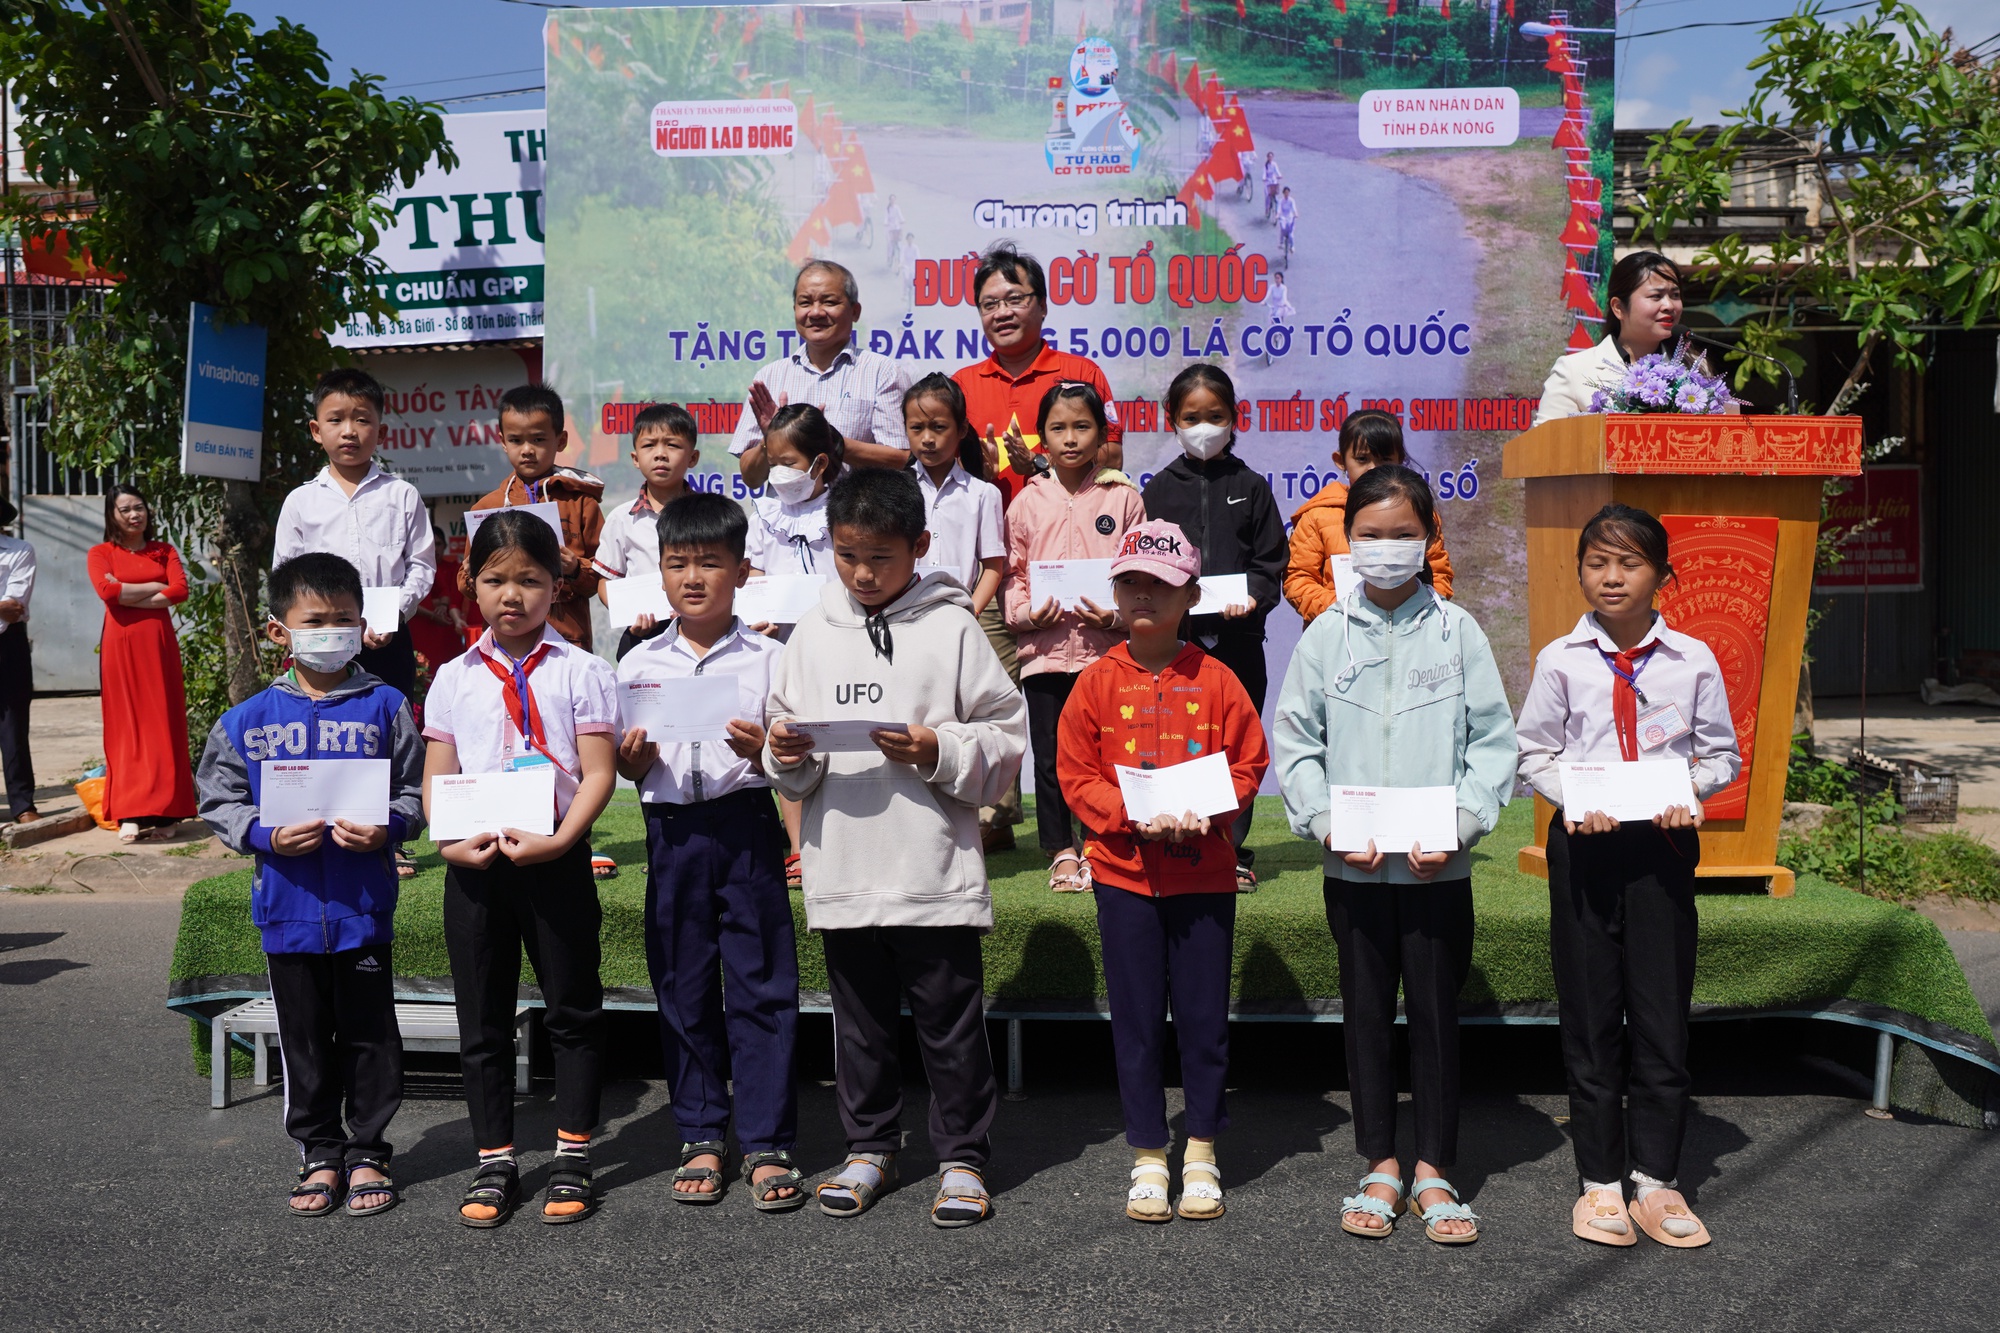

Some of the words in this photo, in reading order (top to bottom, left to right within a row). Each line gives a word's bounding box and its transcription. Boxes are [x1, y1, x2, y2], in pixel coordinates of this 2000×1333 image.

[773, 105, 794, 113] MINH
[1373, 96, 1392, 113] ỦY
[1396, 99, 1425, 112] BAN
[1429, 95, 1470, 111] NHÂN
[1474, 95, 1505, 110] DÂN
[656, 125, 707, 150] NGƯỜI
[711, 126, 743, 149] LAO
[747, 124, 793, 149] ĐỘNG
[1382, 119, 1416, 136] TỈNH
[1453, 119, 1495, 134] NÔNG
[973, 199, 1097, 237] Chương
[1106, 195, 1188, 227] trình
[395, 271, 477, 303] CHUẨN
[483, 275, 529, 297] GPP
[1049, 249, 1100, 306] CỜ
[1108, 240, 1156, 305] TỔ
[1168, 243, 1269, 309] QUỐC
[389, 321, 396, 334] 3
[461, 315, 474, 331] 88
[668, 321, 767, 370] TẶNG
[868, 312, 945, 360] ĐẮK
[1069, 326, 1172, 358] 5.000
[1182, 317, 1230, 357] LÁ
[1241, 316, 1295, 358] CỜ
[1304, 308, 1354, 357] TỔ
[1364, 309, 1471, 358] QUỐC
[198, 360, 260, 387] vinaphone
[1257, 389, 1315, 433] THIỂU
[1409, 396, 1458, 432] SINH
[447, 418, 500, 448] VÂN
[1438, 459, 1479, 500] SỐ
[1407, 662, 1451, 690] Denim
[835, 682, 884, 705] UFO
[1164, 841, 1202, 866] Kitty
